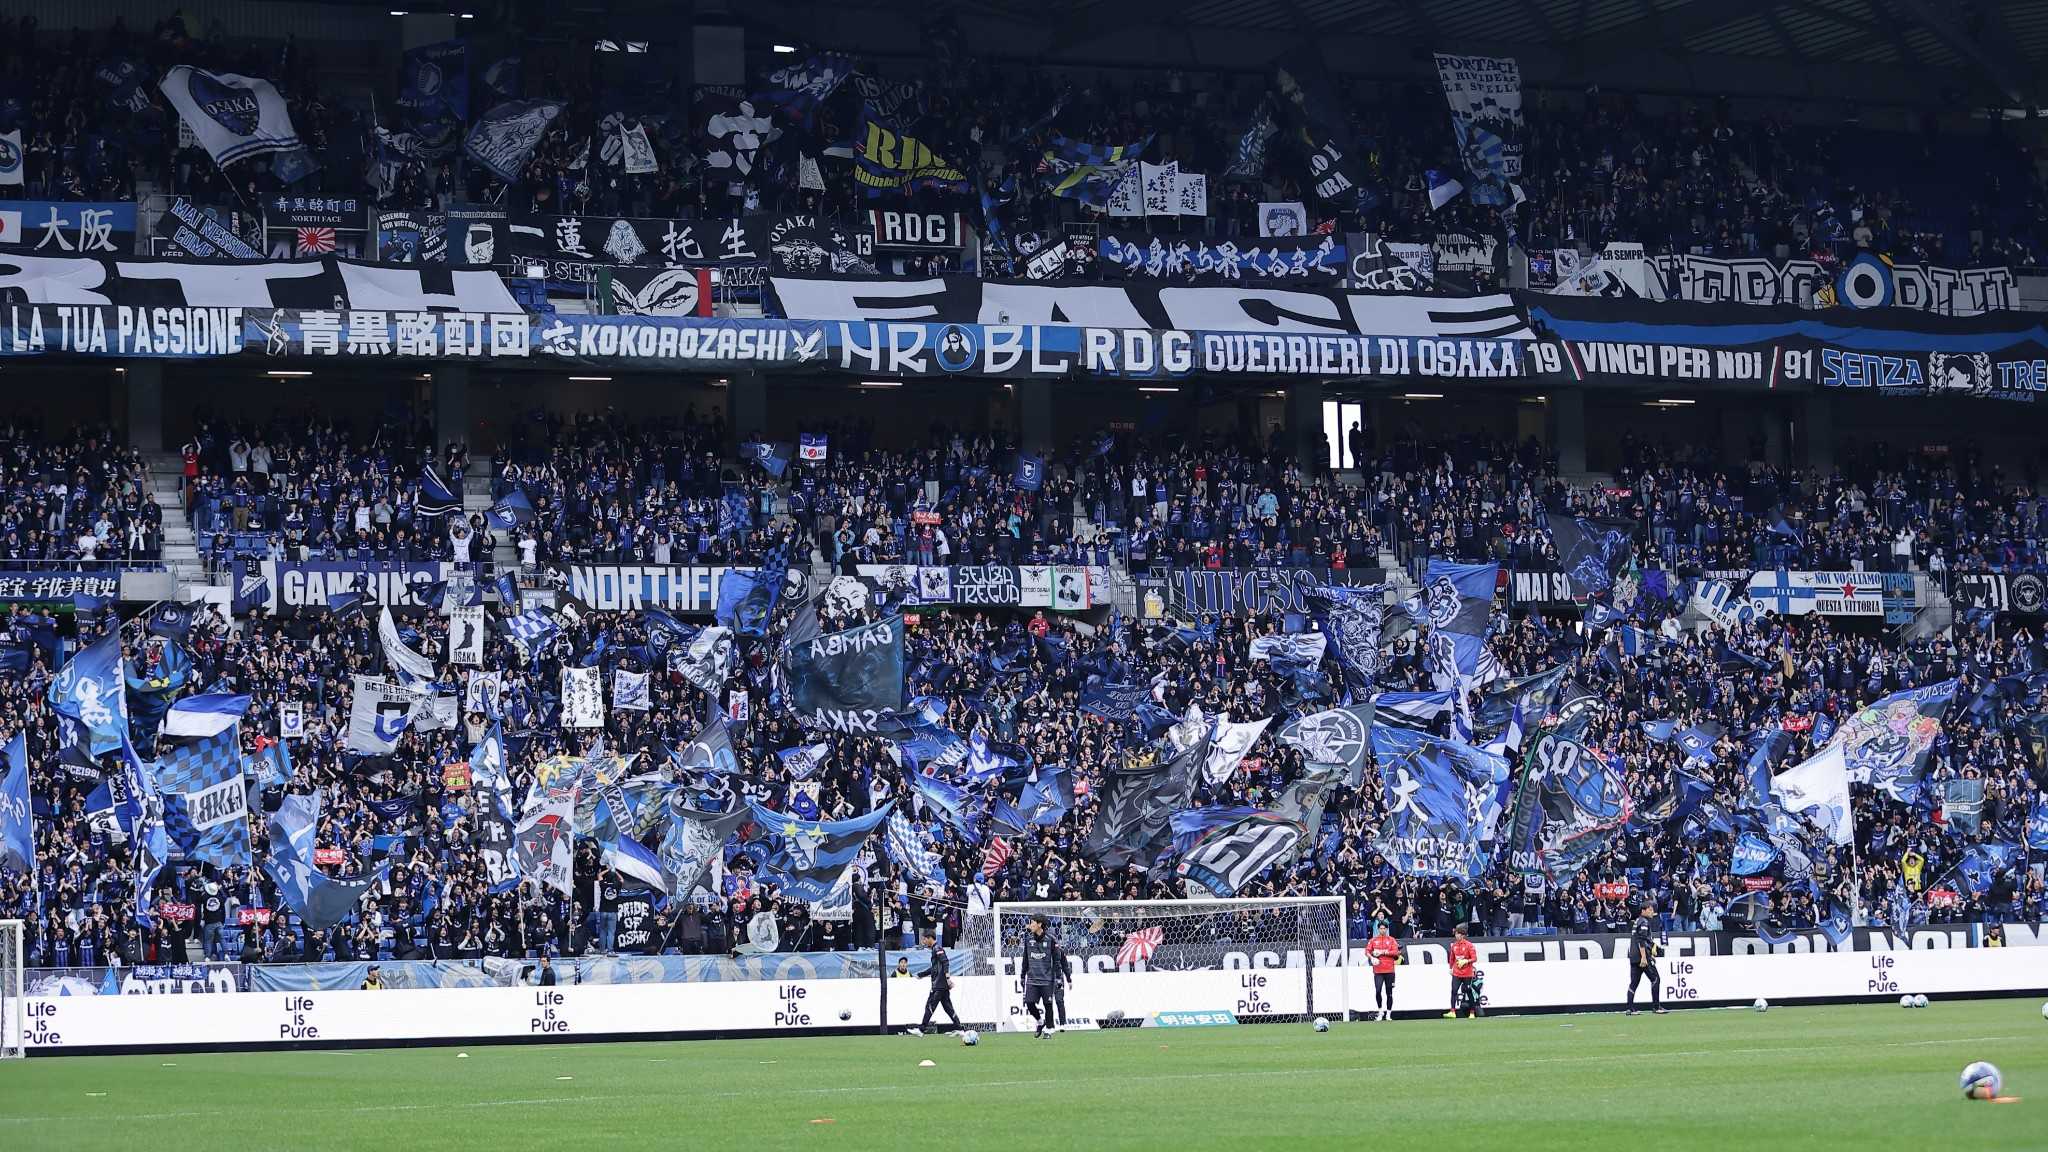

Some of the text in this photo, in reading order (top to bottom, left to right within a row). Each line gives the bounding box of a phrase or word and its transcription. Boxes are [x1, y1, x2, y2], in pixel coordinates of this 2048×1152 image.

[205, 95, 256, 116] OSAKA
[292, 215, 321, 223] NORTH
[379, 212, 410, 223] ASSEMBLE
[34, 207, 118, 252] 大阪
[771, 216, 816, 241] OSAKA
[884, 211, 946, 242] RDG
[510, 217, 757, 260] 一蓮 托生
[856, 234, 872, 255] 13
[12, 305, 243, 354] LA TUA PASSIONE
[299, 311, 529, 357] 青黒酩酊団
[543, 320, 579, 356] 志
[580, 323, 788, 361] KOKOROZASHI
[984, 326, 1070, 374] BL
[1087, 329, 1192, 374] RDG
[1204, 335, 1517, 377] GUERRIERI DI OSAKA
[1529, 343, 1812, 380] 19 VINCI PER NOI 91
[1822, 349, 1924, 388] SENZA
[959, 565, 1014, 586] SENZA
[1815, 573, 1881, 586] NOI VOGLIAMO
[31, 577, 117, 598] 宇佐美貴史
[954, 584, 1020, 604] TREGUA
[1516, 572, 1575, 602] MAI SO
[1816, 600, 1880, 613] QUESTA VITTORIA
[454, 651, 477, 663] OSAKA
[1528, 735, 1579, 783] SO
[1190, 885, 1210, 896] OSA
[617, 900, 649, 918] PRIDE
[625, 916, 643, 930] OF
[1671, 962, 1693, 976] Life
[1872, 956, 1894, 970] Life
[1242, 974, 1266, 987] Life
[1678, 976, 1686, 987] is
[1879, 969, 1887, 981] is
[537, 991, 564, 1005] Life
[780, 985, 806, 999] Life
[1250, 989, 1259, 1001] is
[28, 1002, 56, 1016] Life
[286, 997, 314, 1011] Life
[788, 1003, 798, 1013] is
[294, 1012, 304, 1025] is
[545, 1007, 555, 1019] is
[1160, 1014, 1230, 1025] 明治安田
[36, 1018, 47, 1031] is
